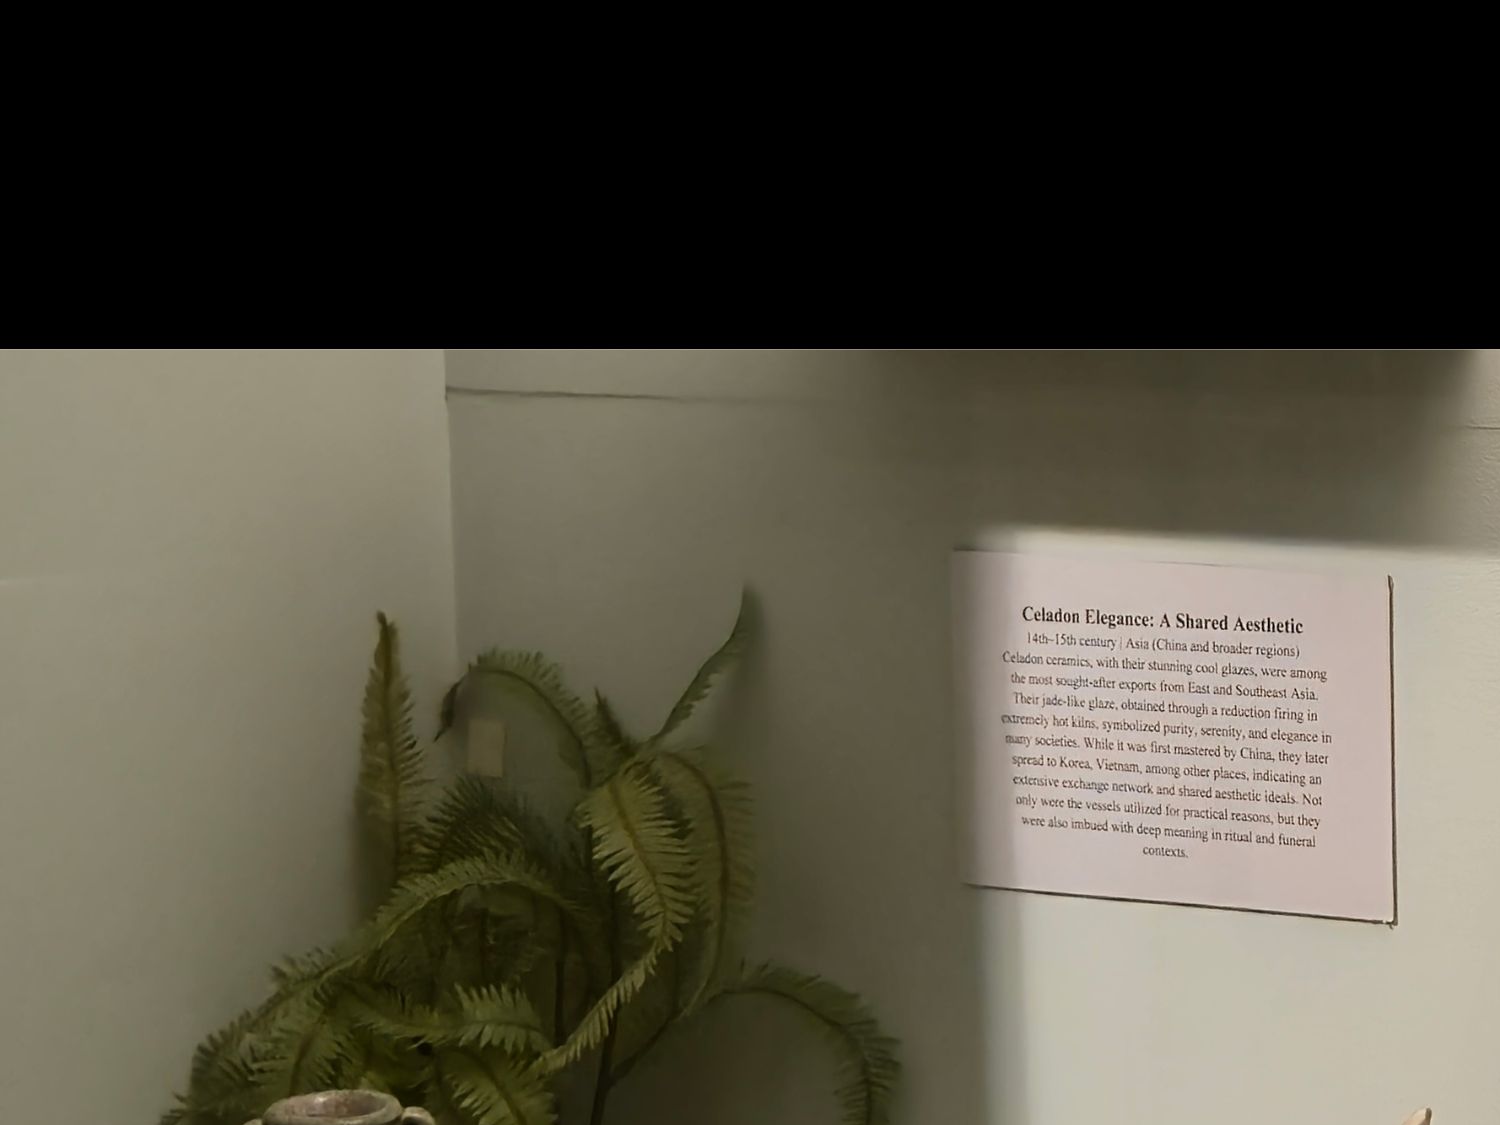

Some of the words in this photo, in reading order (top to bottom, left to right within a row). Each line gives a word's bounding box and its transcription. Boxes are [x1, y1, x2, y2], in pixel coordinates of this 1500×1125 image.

[1022, 606, 1080, 624] Celadon
[1085, 609, 1154, 629] Elegance:
[1159, 613, 1171, 628] A
[1176, 613, 1228, 631] Shared
[1233, 616, 1303, 634] Aesthetic
[1079, 637, 1117, 651] century
[1125, 637, 1150, 650] Asia
[1151, 638, 1188, 652] (China
[1190, 640, 1210, 653] and
[1212, 640, 1253, 655] broader
[1255, 643, 1300, 660] regions)
[1002, 650, 1044, 665] Celadon
[1045, 656, 1093, 669] ceramics,
[1096, 656, 1120, 669] with
[1121, 657, 1146, 670] their
[1147, 659, 1193, 676] stunning
[1195, 661, 1218, 674] cool
[1221, 662, 1258, 678] glazes,
[1260, 667, 1287, 678] were
[1289, 669, 1328, 683] among
[1011, 672, 1026, 684] the
[1028, 676, 1053, 686] most
[1055, 675, 1116, 690] sought-after
[1118, 681, 1157, 694] exports
[1160, 679, 1185, 693] from
[1188, 681, 1210, 694] East
[1213, 684, 1233, 696] and
[1235, 684, 1287, 699] Southeast
[1290, 687, 1318, 701] Asia.
[1015, 692, 1040, 705] Their
[1041, 694, 1086, 708] jade-like
[1088, 696, 1119, 712] glaze,
[1120, 698, 1166, 713] obtained
[1168, 700, 1209, 718] through
[1211, 706, 1218, 716] a
[1220, 704, 1271, 719] reduction
[1274, 706, 1304, 724] firing
[1307, 709, 1318, 722] in
[1012, 754, 1044, 767] spread
[1046, 757, 1057, 768] to
[1059, 755, 1093, 771] Korea,
[1096, 758, 1143, 775] Vietnam,
[1145, 765, 1181, 779] among
[1183, 764, 1211, 778] other
[1213, 766, 1249, 782] places,
[1252, 768, 1307, 788] indicating
[1309, 775, 1322, 785] an
[1012, 775, 1059, 788] extensive
[1061, 777, 1109, 794] exchange
[1112, 782, 1154, 795] network
[1156, 784, 1176, 796] and
[1178, 784, 1213, 799] shared
[1214, 788, 1262, 802] aesthetic
[1264, 789, 1299, 805] ideals.
[1302, 793, 1322, 806] Not
[1142, 846, 1188, 858] contexts.
